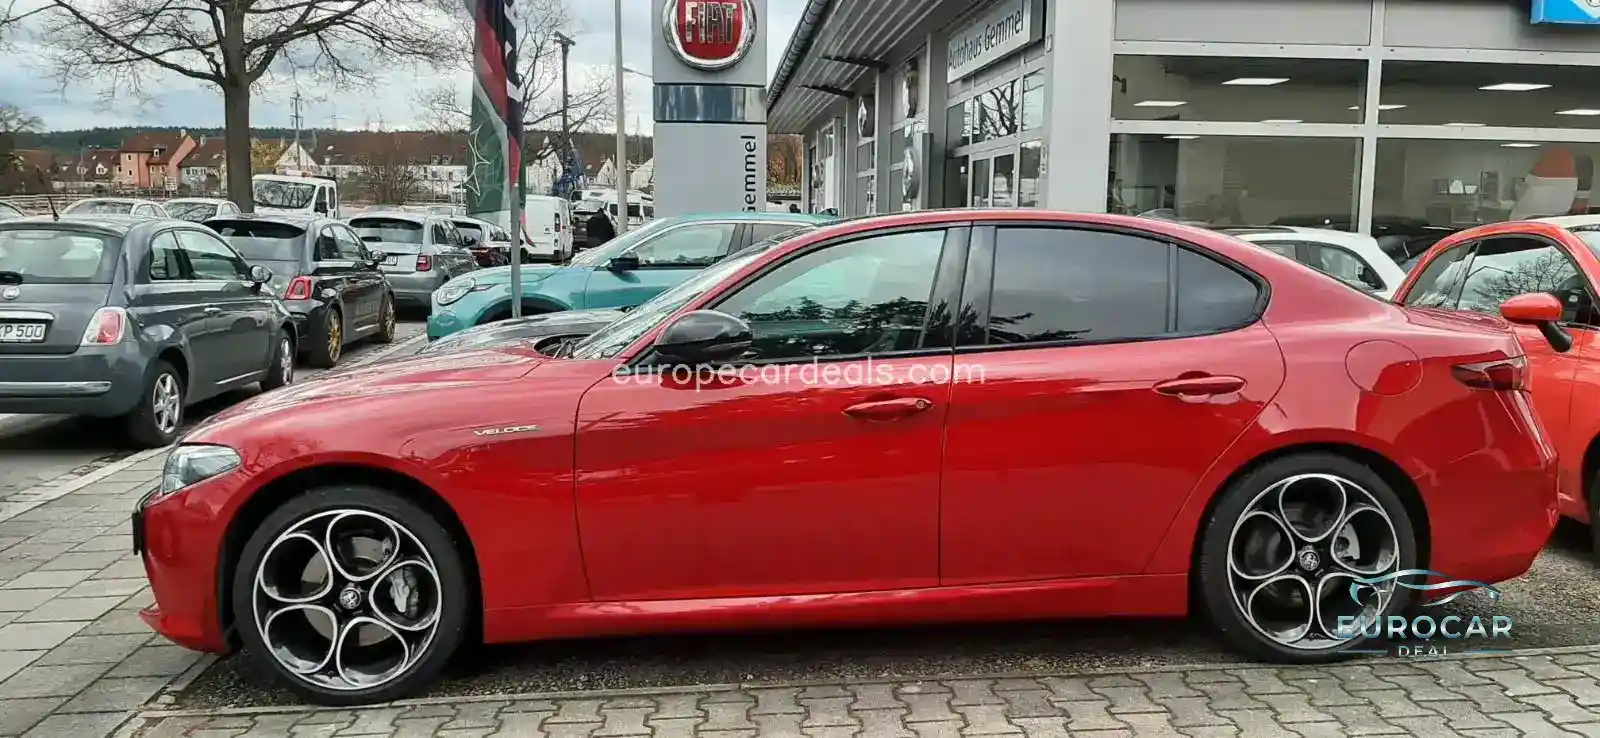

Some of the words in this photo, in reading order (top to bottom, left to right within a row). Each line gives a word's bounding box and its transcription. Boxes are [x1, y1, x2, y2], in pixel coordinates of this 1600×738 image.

[685, 1, 738, 43] FIAT
[949, 35, 982, 69] Autohaus
[984, 0, 1024, 51] Gemmel
[16, 325, 44, 337] 500
[473, 425, 539, 436] VELOCE
